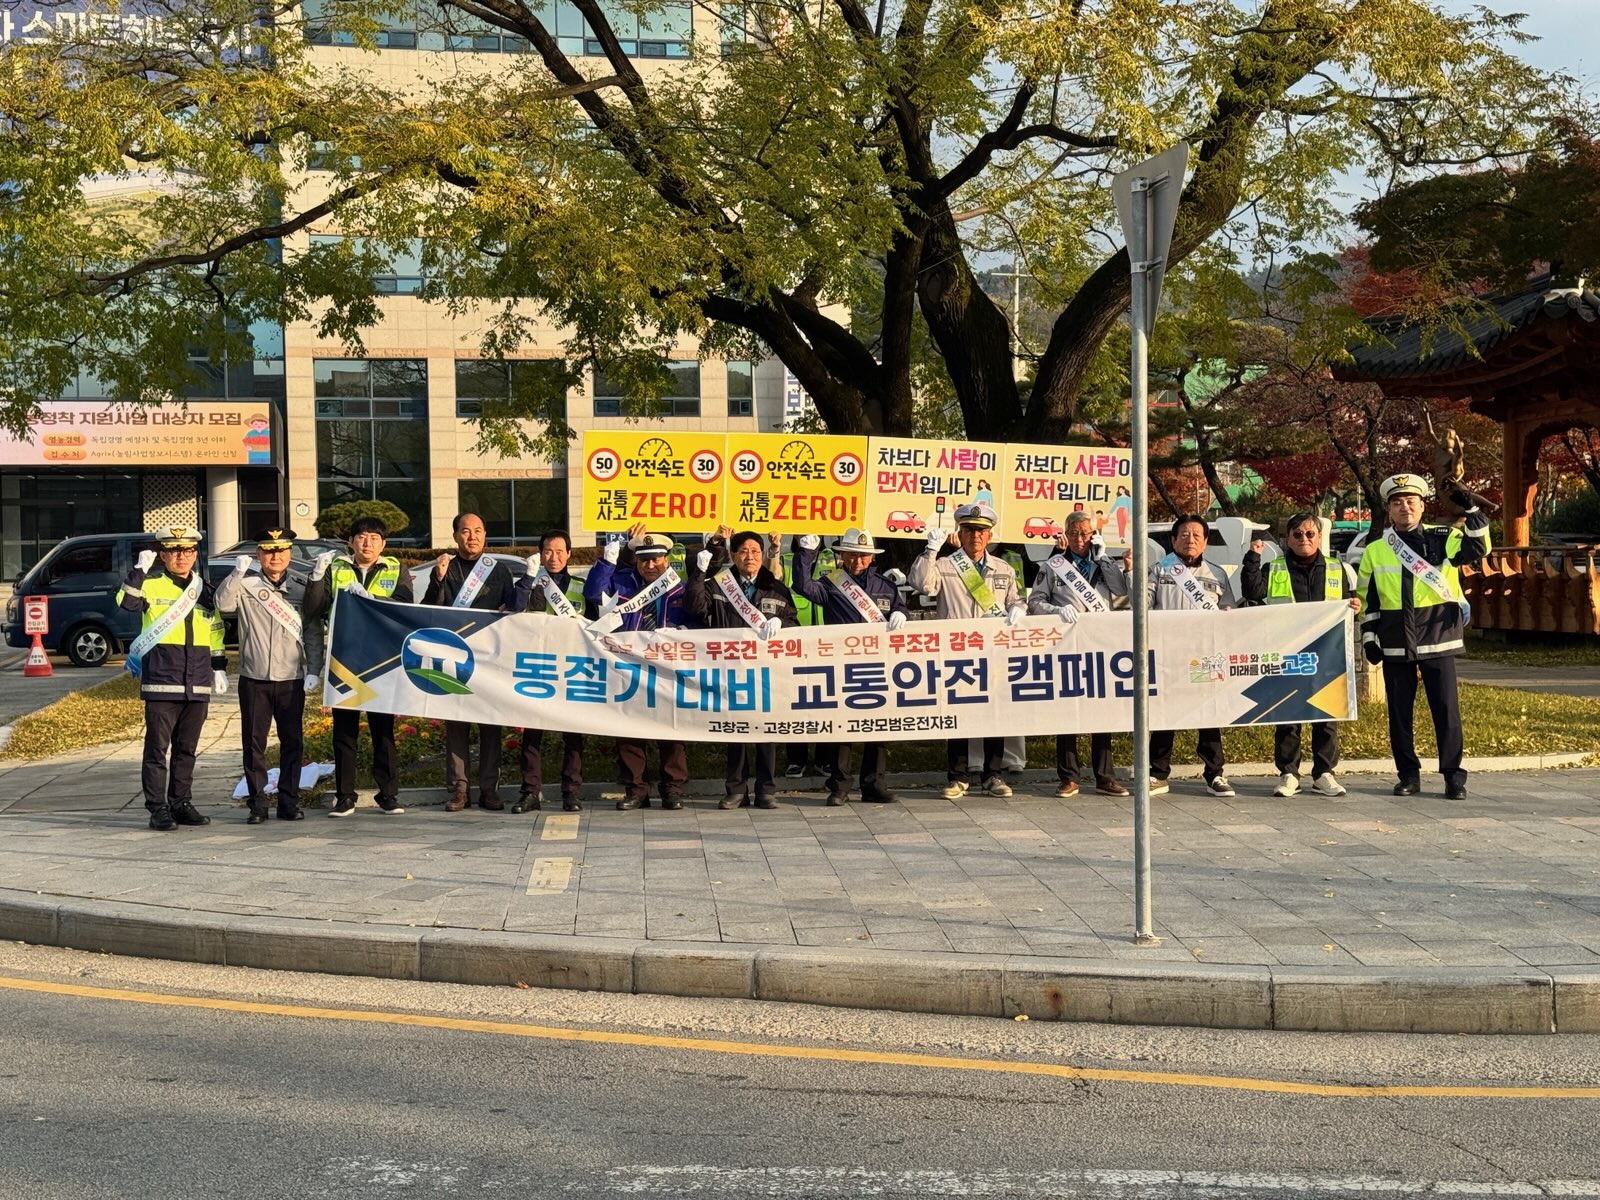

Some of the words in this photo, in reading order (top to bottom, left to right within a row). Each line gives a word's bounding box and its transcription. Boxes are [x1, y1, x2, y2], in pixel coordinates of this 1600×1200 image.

[79, 411, 148, 426] 지원사업
[152, 411, 205, 426] 대상자
[208, 412, 242, 426] 모집
[596, 457, 613, 470] 50
[624, 458, 685, 478] 안전속도
[697, 459, 715, 472] 30
[738, 459, 756, 472] 50
[838, 462, 856, 474] 30
[877, 447, 931, 468] 차보다
[936, 448, 996, 471] 사람이
[1014, 454, 1069, 475] 차보다
[766, 461, 826, 480] 안전속도
[877, 471, 972, 496] 먼저입니다
[1014, 477, 1111, 502] 먼저입니다
[597, 489, 628, 505] 교통
[631, 492, 717, 519] ZERO!
[739, 491, 770, 507] 교통
[597, 506, 628, 521] 사고
[739, 507, 769, 523] 사고
[772, 494, 858, 522] ZERO!
[550, 592, 575, 618] 음주
[841, 580, 886, 622] 무리한추
[643, 641, 697, 661] 살얼음
[706, 639, 758, 661] 무조건
[817, 637, 834, 658] 눈
[843, 634, 879, 657] 오면
[888, 632, 941, 655] 무조건
[949, 631, 984, 652] 감속
[992, 627, 1063, 650] 속도준수
[1229, 664, 1259, 676] 미래를
[1260, 663, 1281, 676] 여는
[1281, 652, 1319, 675] 고창
[512, 651, 657, 708] 동절기
[675, 666, 771, 712] 대비
[790, 657, 989, 710] 교통안전
[1007, 649, 1158, 702] 캠페인
[708, 720, 750, 734] 고창군
[763, 720, 833, 735] 고창경찰서
[846, 715, 958, 734] 고창모범운전자회
